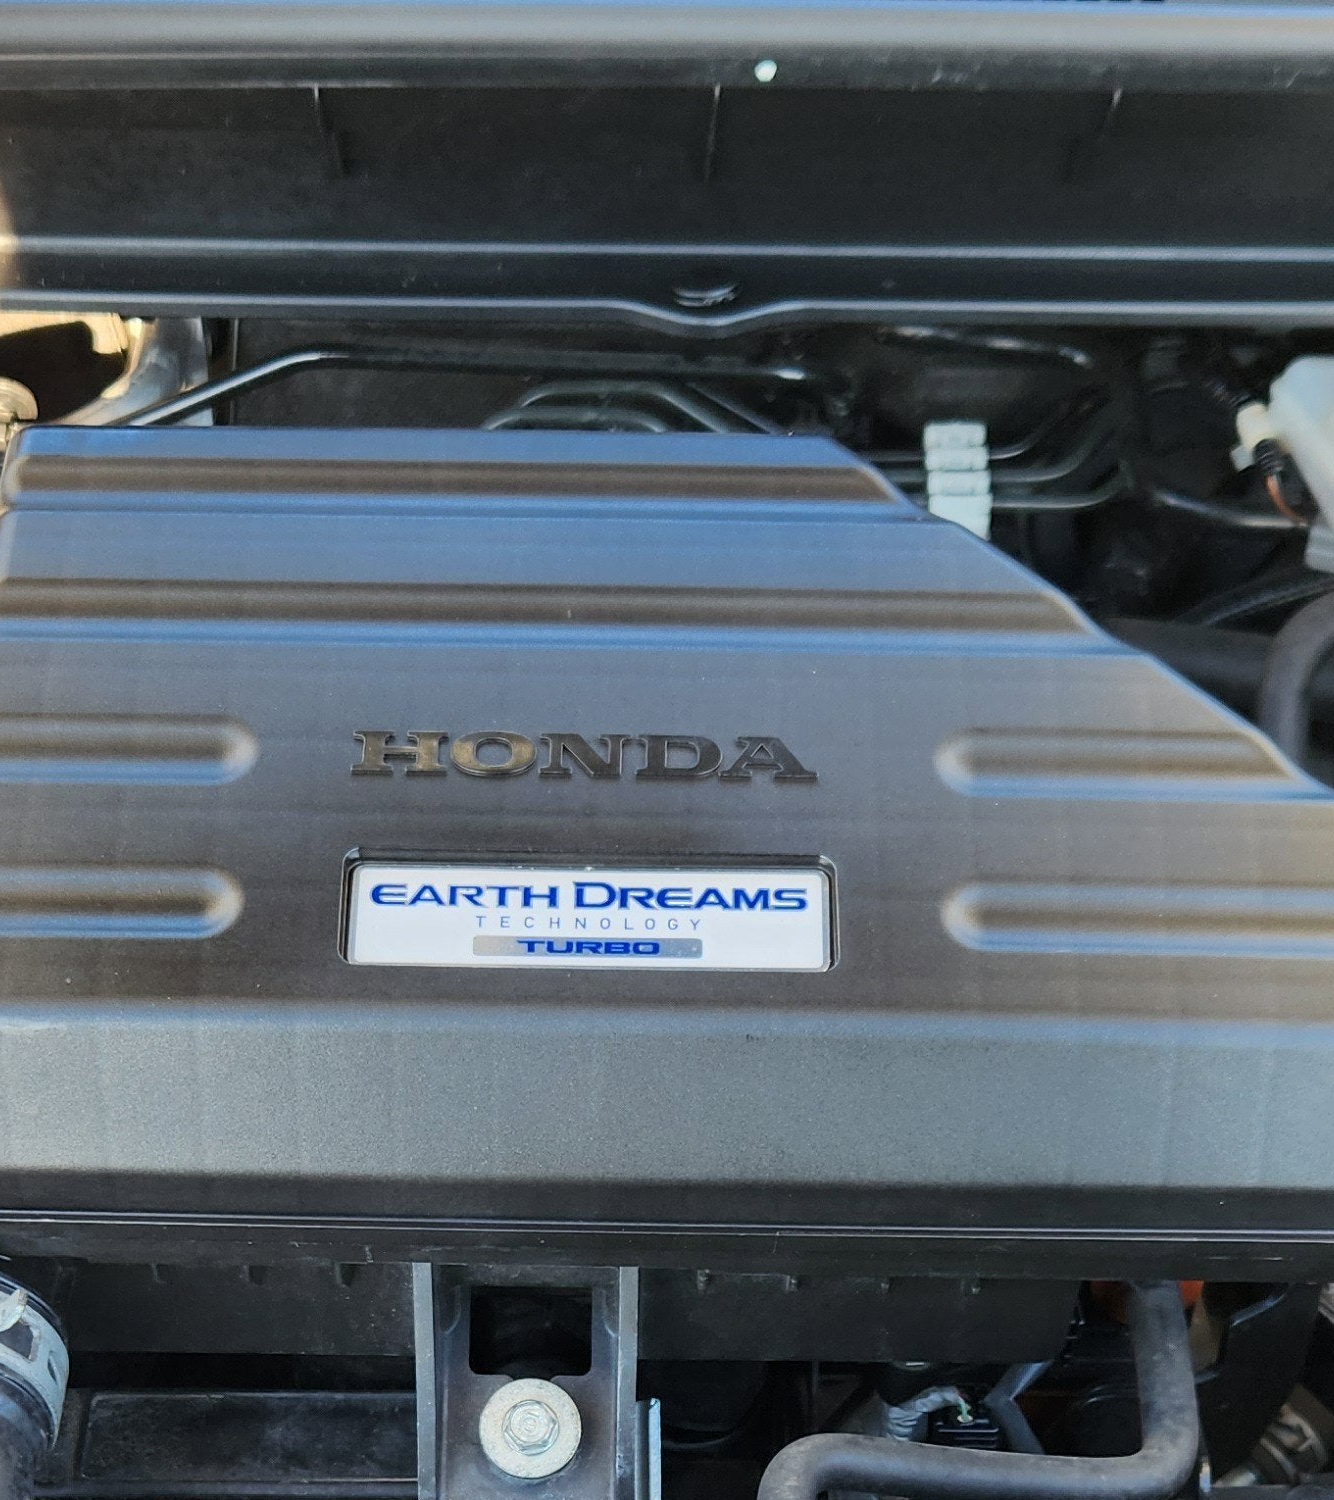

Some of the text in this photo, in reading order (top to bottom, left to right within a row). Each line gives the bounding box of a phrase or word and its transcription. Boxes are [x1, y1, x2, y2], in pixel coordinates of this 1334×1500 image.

[351, 730, 818, 783] HONDA
[370, 881, 809, 911] EARTH DREAMS
[476, 915, 703, 931] TECHNOLOGY
[517, 940, 661, 956] TURBO
